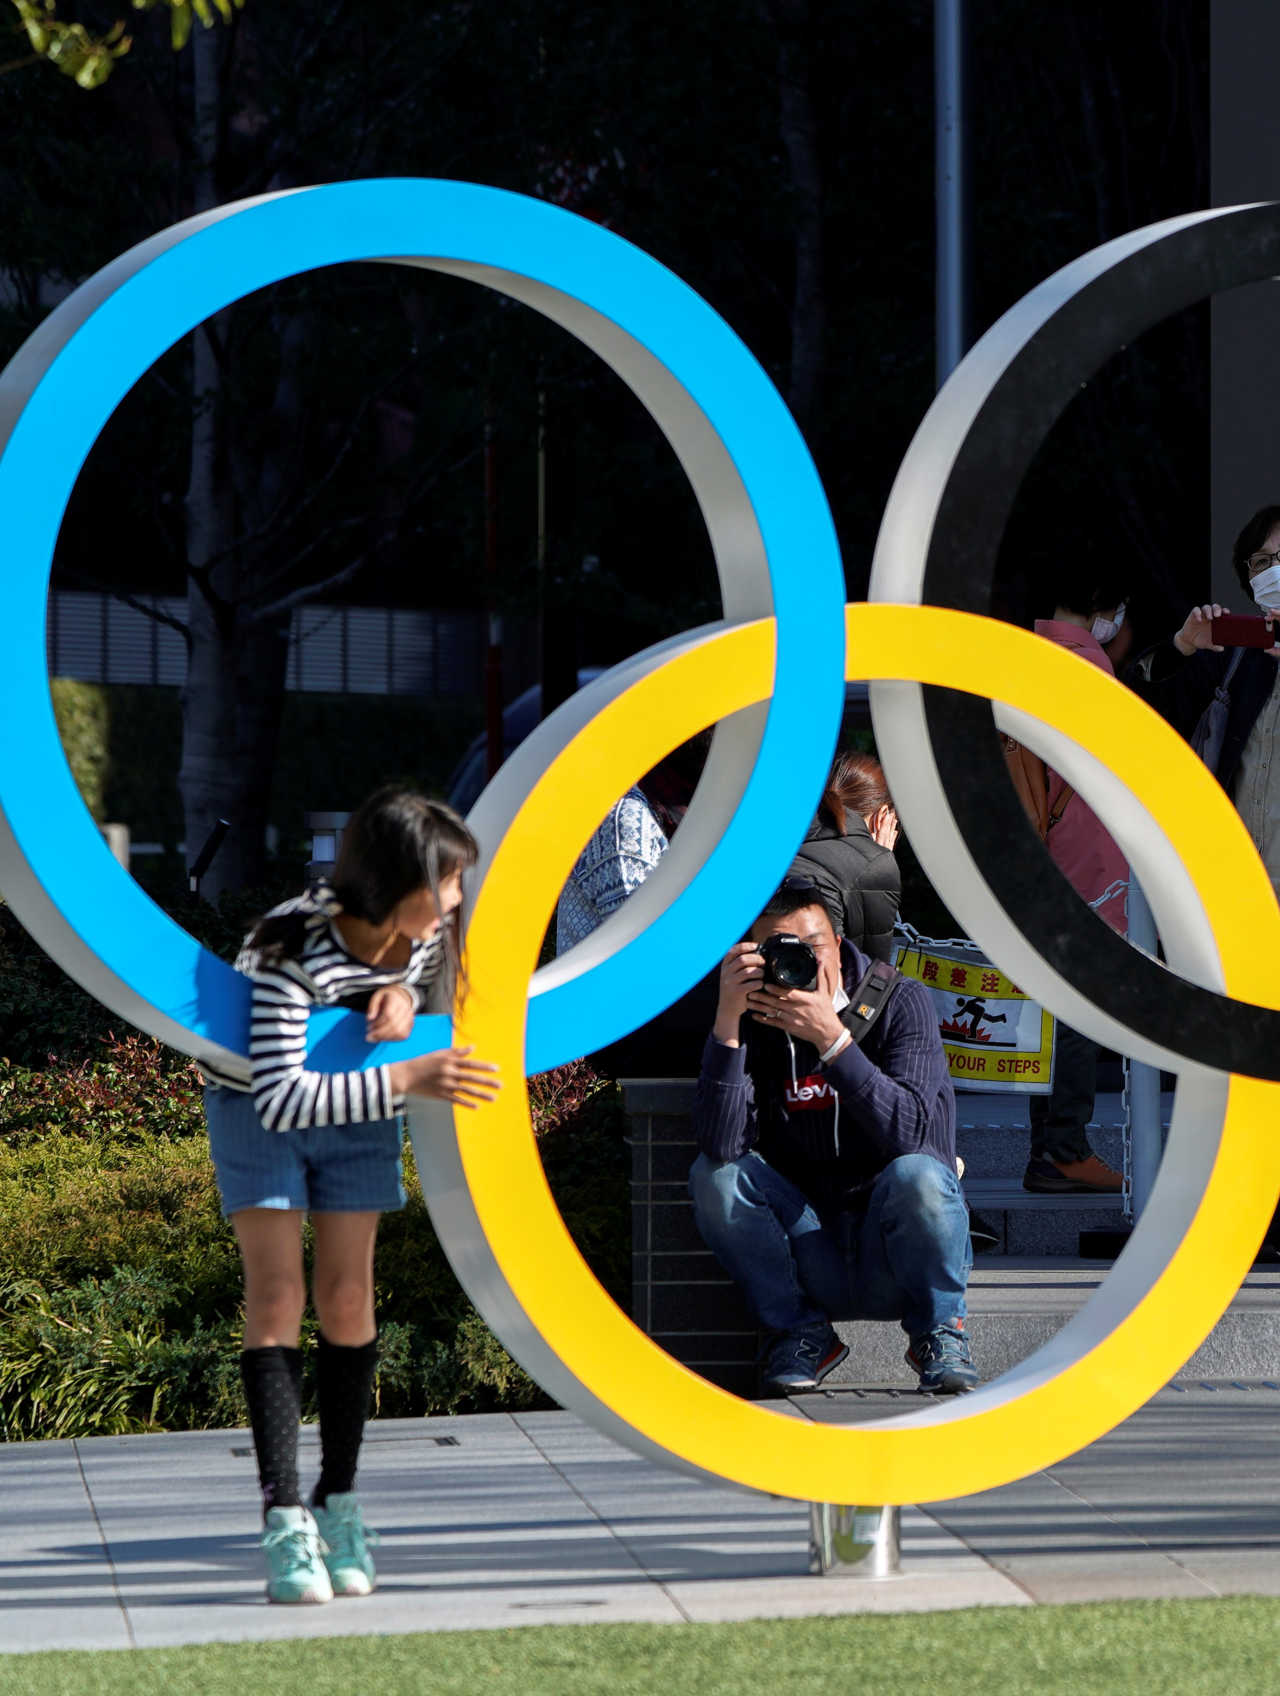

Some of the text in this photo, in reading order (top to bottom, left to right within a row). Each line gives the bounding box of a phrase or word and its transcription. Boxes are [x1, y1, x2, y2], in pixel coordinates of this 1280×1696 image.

[922, 960, 1024, 994] 段差注
[948, 1052, 1041, 1074] YOUR STEPS
